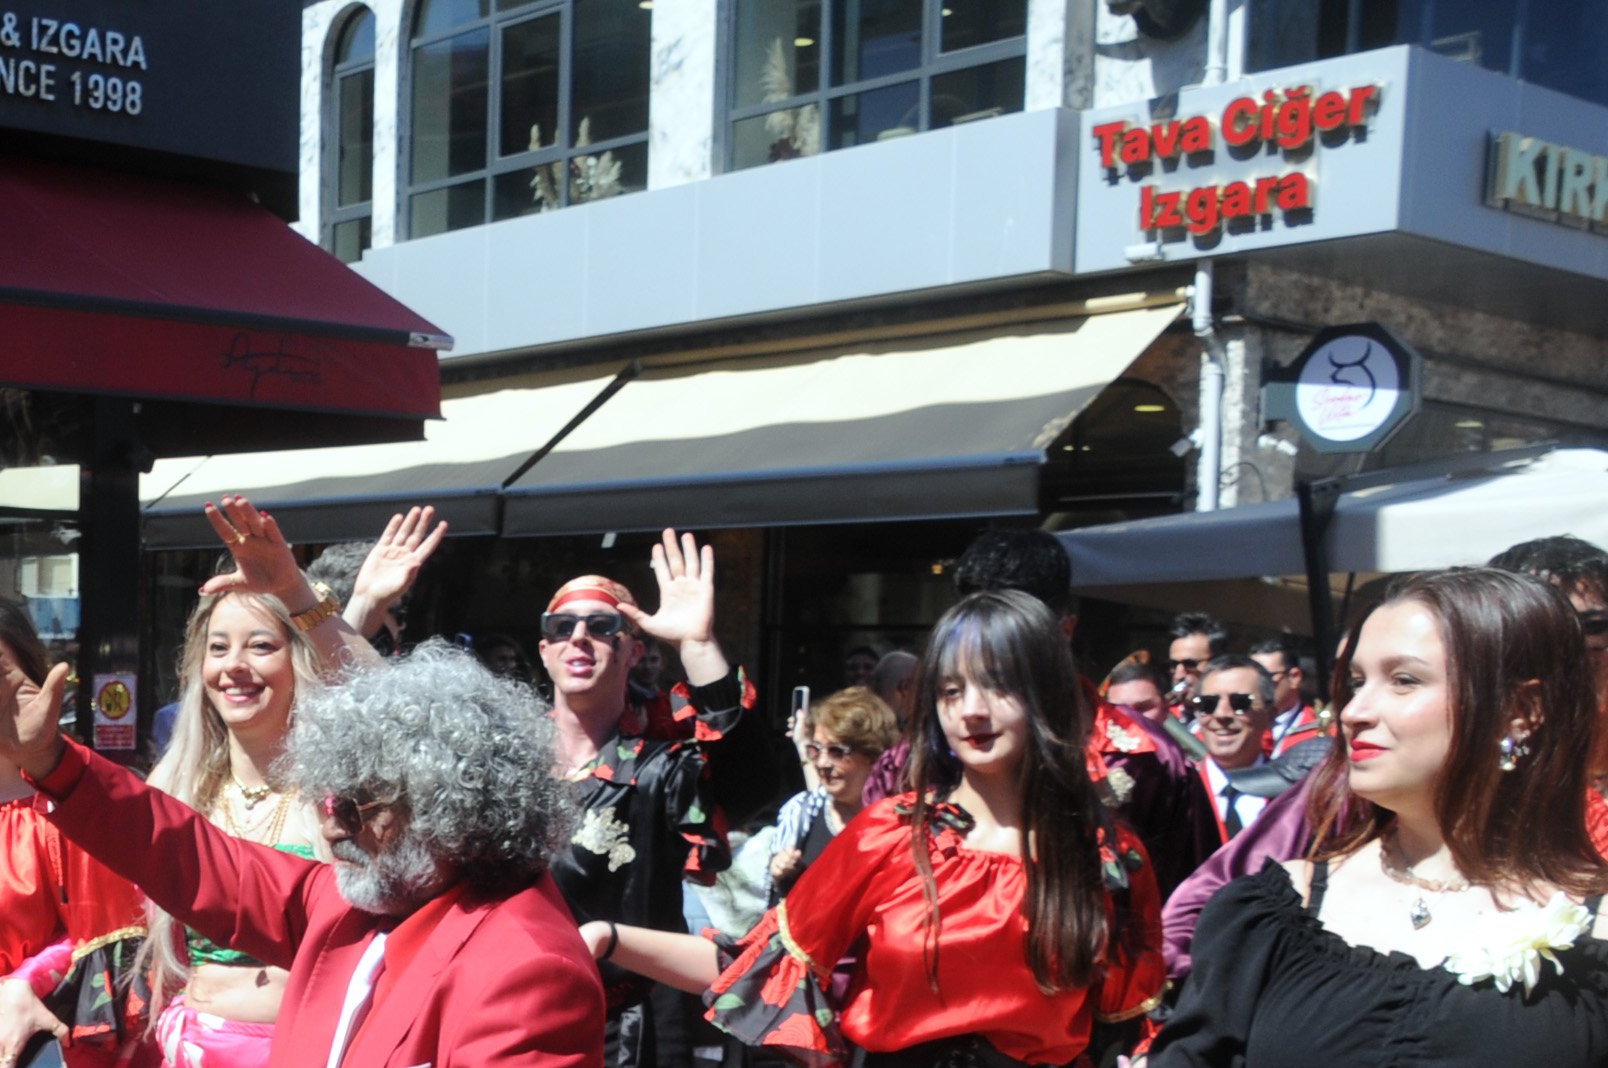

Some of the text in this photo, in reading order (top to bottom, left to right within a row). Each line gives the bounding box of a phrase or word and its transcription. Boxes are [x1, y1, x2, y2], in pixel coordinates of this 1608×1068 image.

[0, 11, 21, 49] &
[31, 17, 148, 71] IZGARA
[71, 71, 143, 116] 1998
[1093, 84, 1378, 169] Tava Ciğer
[1140, 171, 1310, 236] Izgara
